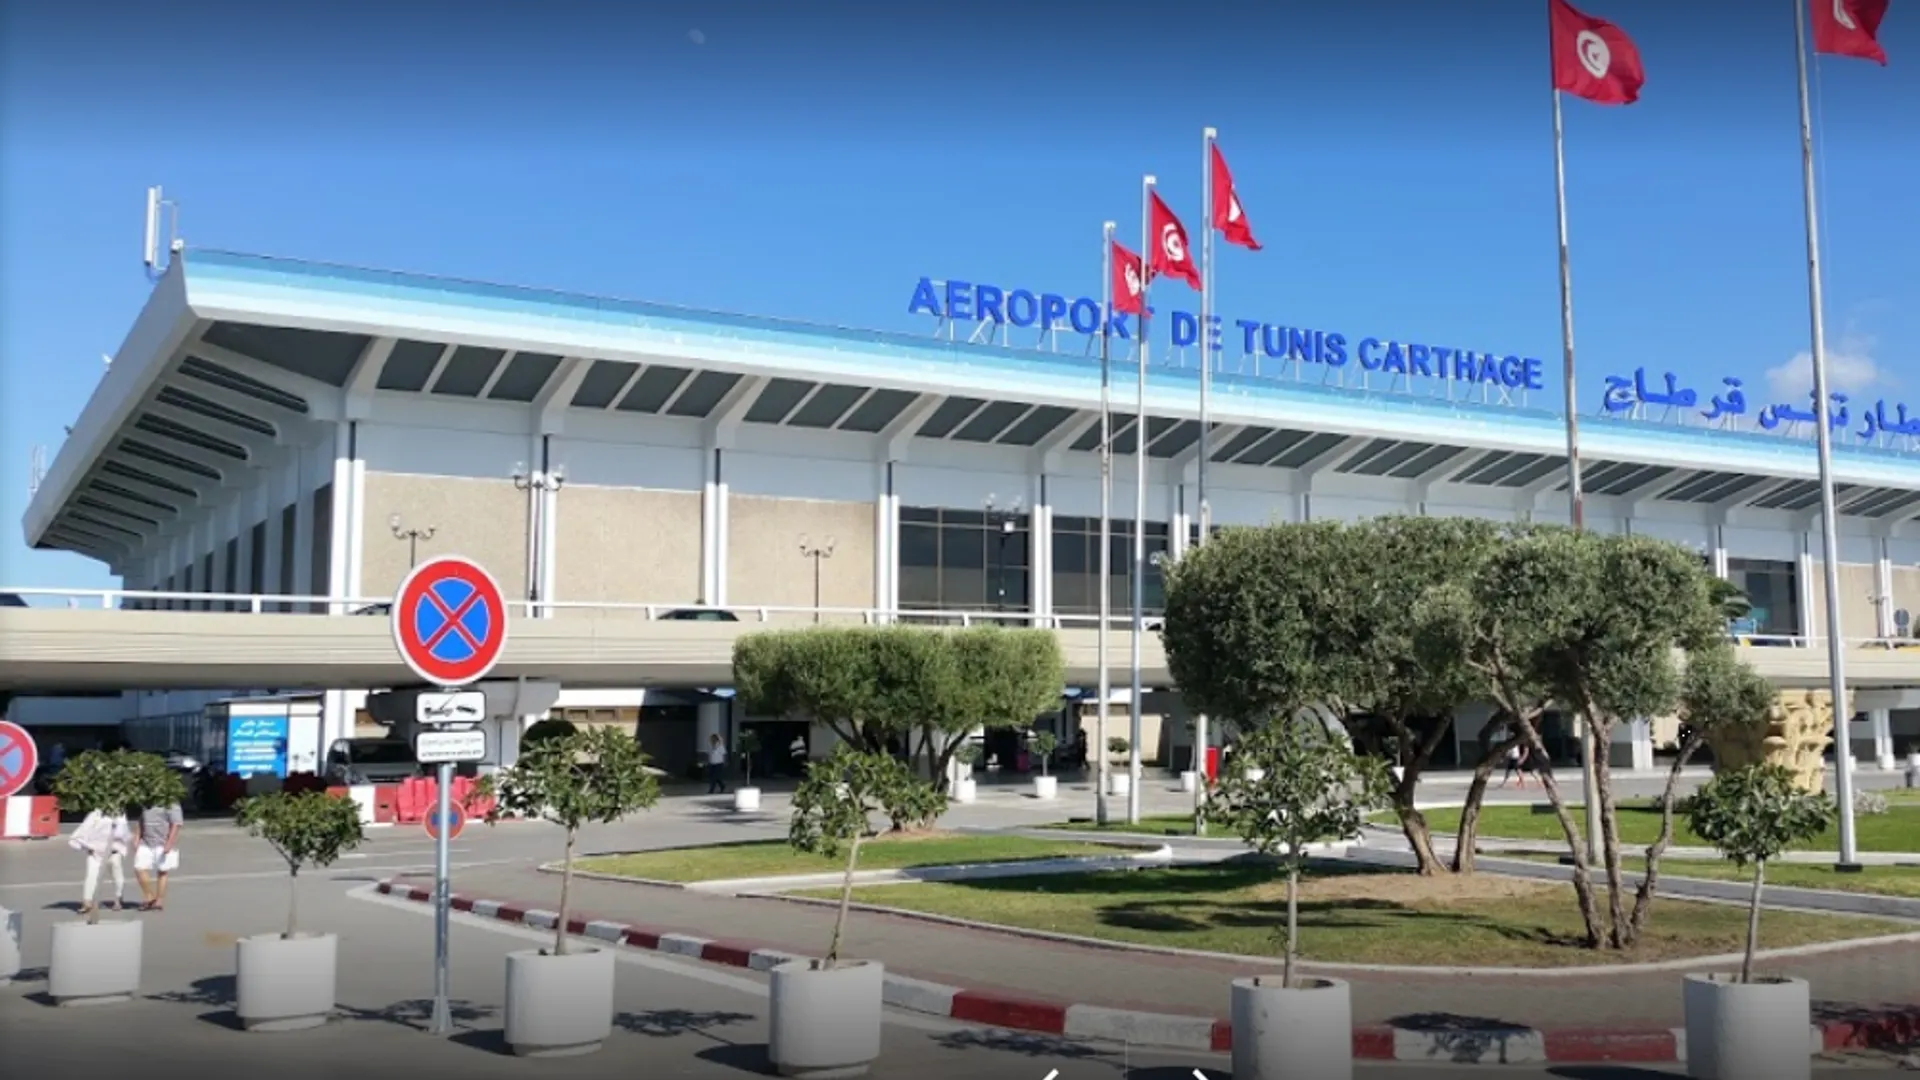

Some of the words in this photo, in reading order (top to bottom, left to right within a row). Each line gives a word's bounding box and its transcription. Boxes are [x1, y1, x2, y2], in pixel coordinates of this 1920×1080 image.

[908, 276, 1155, 342] AEROPOR
[1171, 310, 1222, 351] DE
[1236, 319, 1347, 367] TUNIS
[1358, 337, 1543, 389] CARTHAGE
[1856, 398, 1920, 438] طار
